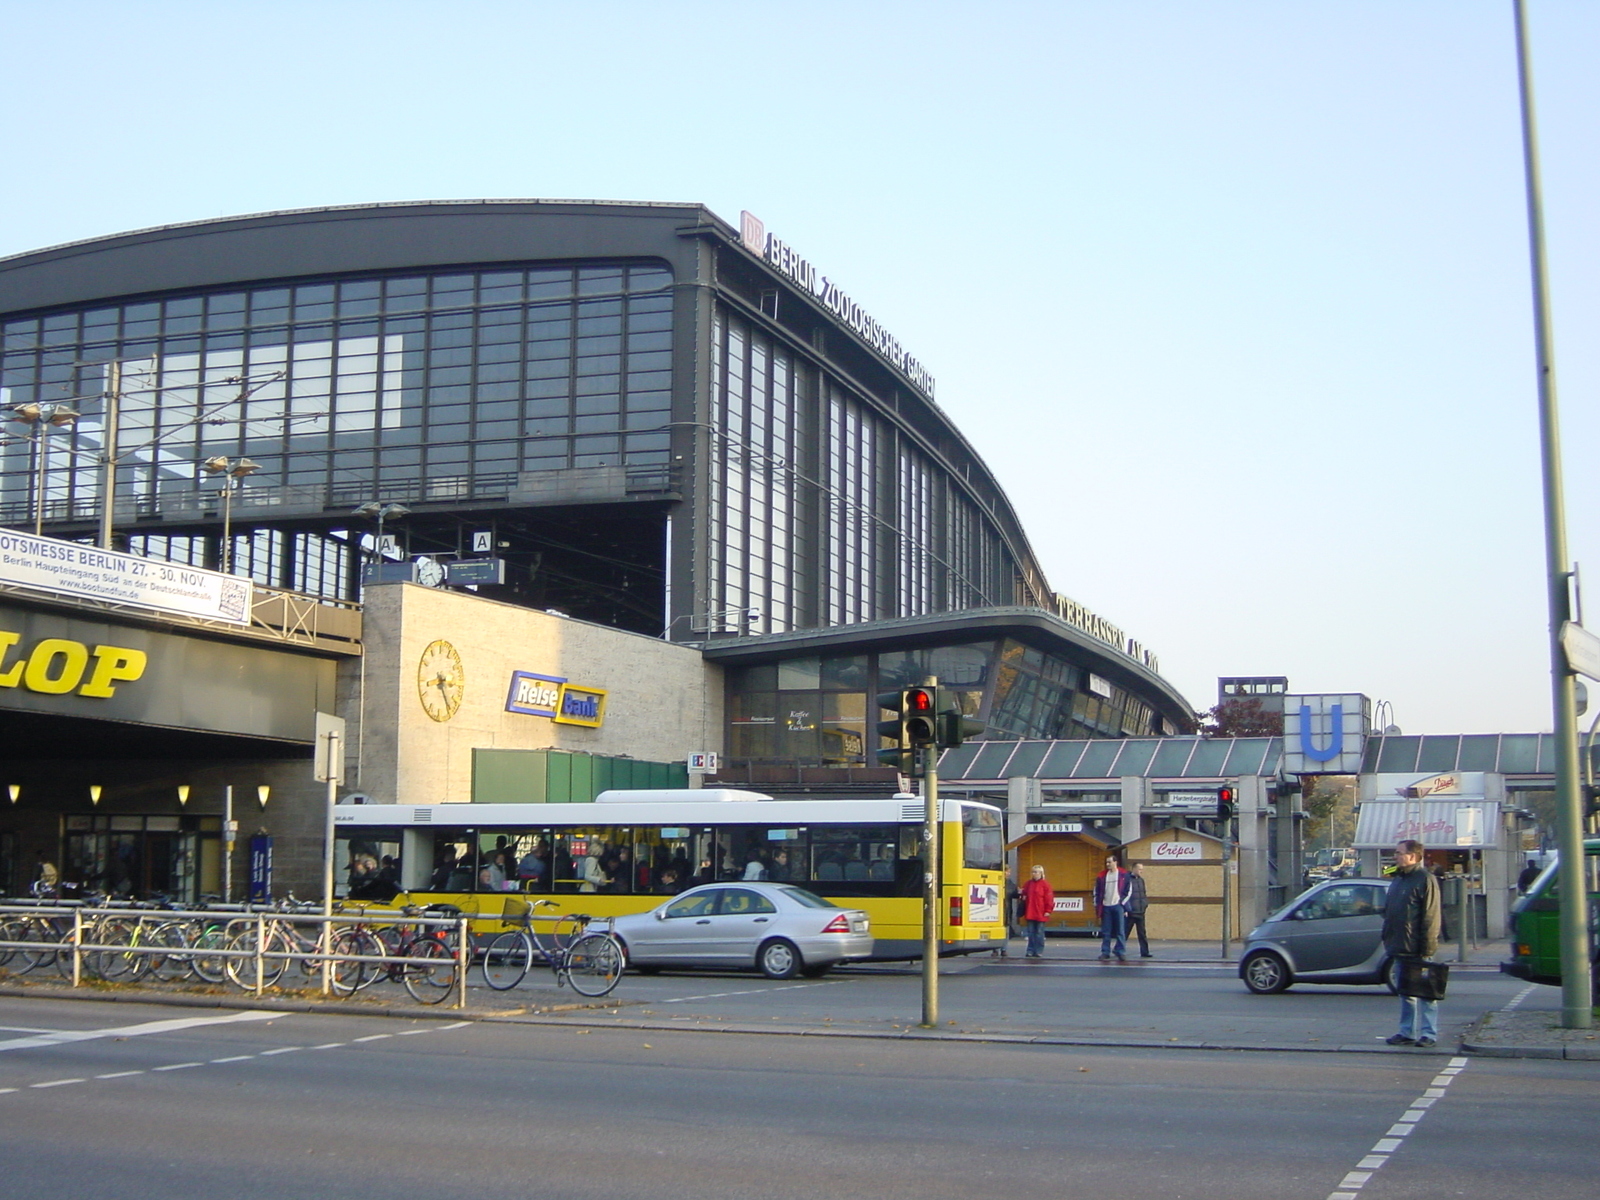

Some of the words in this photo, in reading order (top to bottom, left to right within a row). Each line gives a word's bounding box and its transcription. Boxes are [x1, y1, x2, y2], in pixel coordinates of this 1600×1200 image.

[746, 215, 762, 249] DB
[768, 233, 818, 296] BERLIN
[822, 276, 906, 370] ZOOLOGISCHER
[904, 352, 937, 400] GARTEN
[381, 538, 391, 551] A
[477, 535, 487, 548] A
[0, 536, 74, 564] OTSMESSE
[79, 551, 126, 573] BERLIN
[131, 562, 148, 577] 27.
[160, 567, 176, 582] 30.
[180, 571, 207, 588] NOV.
[3, 554, 32, 568] Berlin
[35, 560, 99, 582] Haupteingang
[102, 572, 119, 584] Süd
[123, 578, 132, 586] an
[134, 579, 147, 589] der
[367, 567, 373, 576] 2
[1055, 592, 1126, 652] TERRASSEN
[0, 630, 148, 699] LOP
[516, 681, 559, 707] Reise
[563, 692, 599, 717] Bank
[1299, 704, 1343, 763] U
[692, 755, 704, 767] EC
[1032, 824, 1075, 832] MARRONI
[1156, 842, 1196, 858] Crêpes
[1053, 899, 1081, 909] rroni
